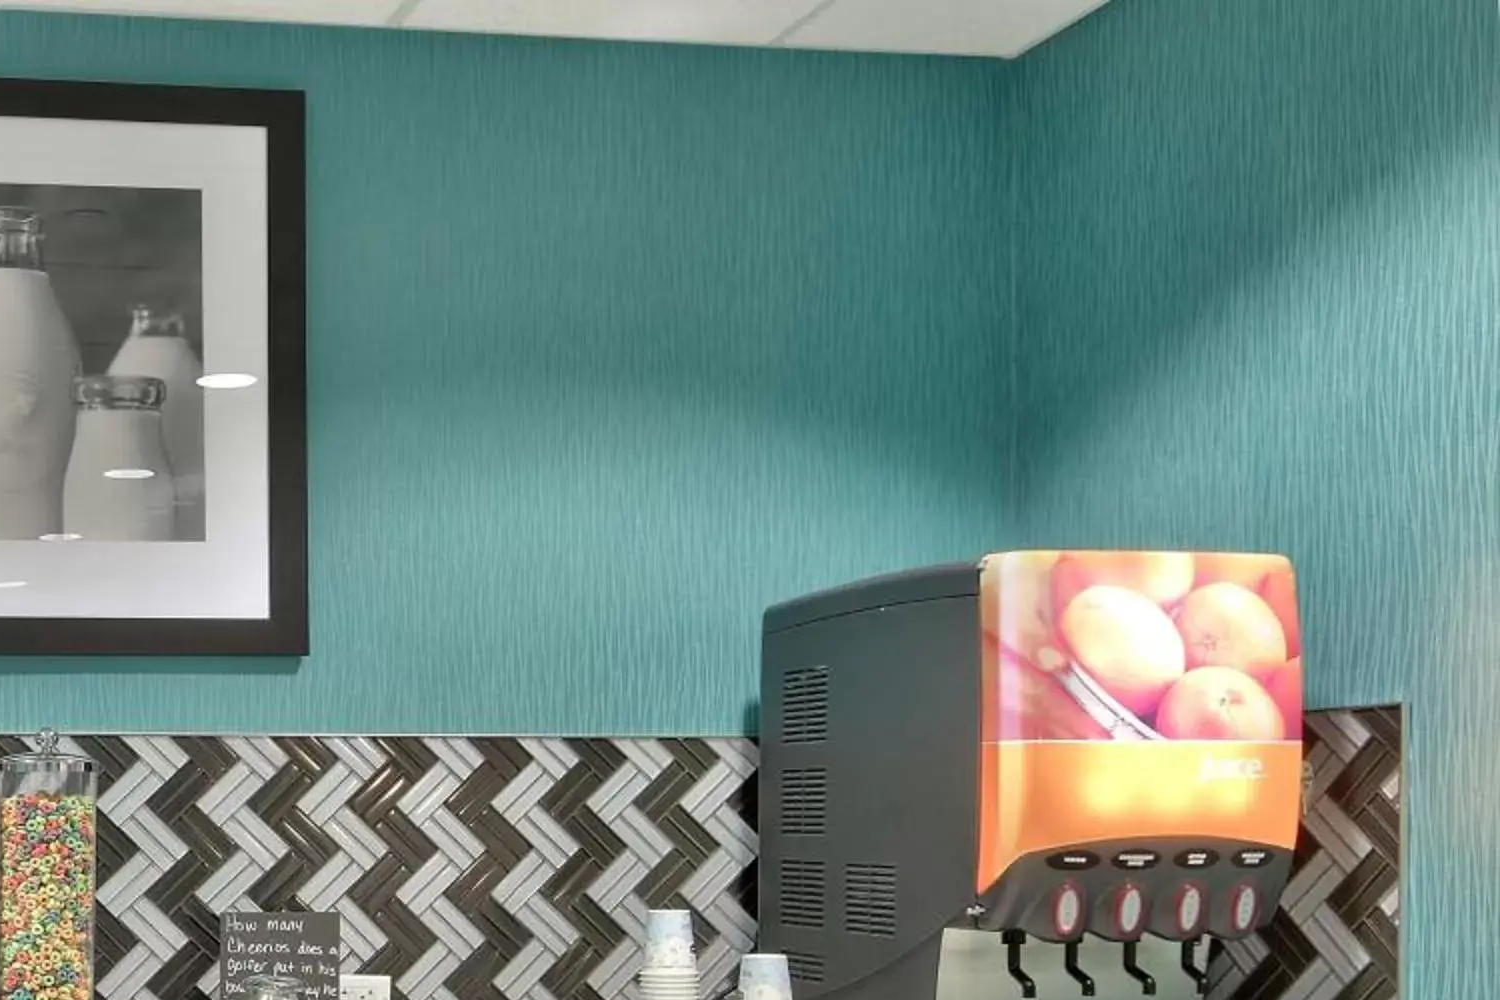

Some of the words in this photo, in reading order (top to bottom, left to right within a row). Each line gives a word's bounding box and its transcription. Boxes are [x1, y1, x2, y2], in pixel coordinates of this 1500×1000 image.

[226, 914, 257, 933] How
[267, 919, 304, 933] many
[297, 940, 323, 955] does
[273, 961, 294, 977] put
